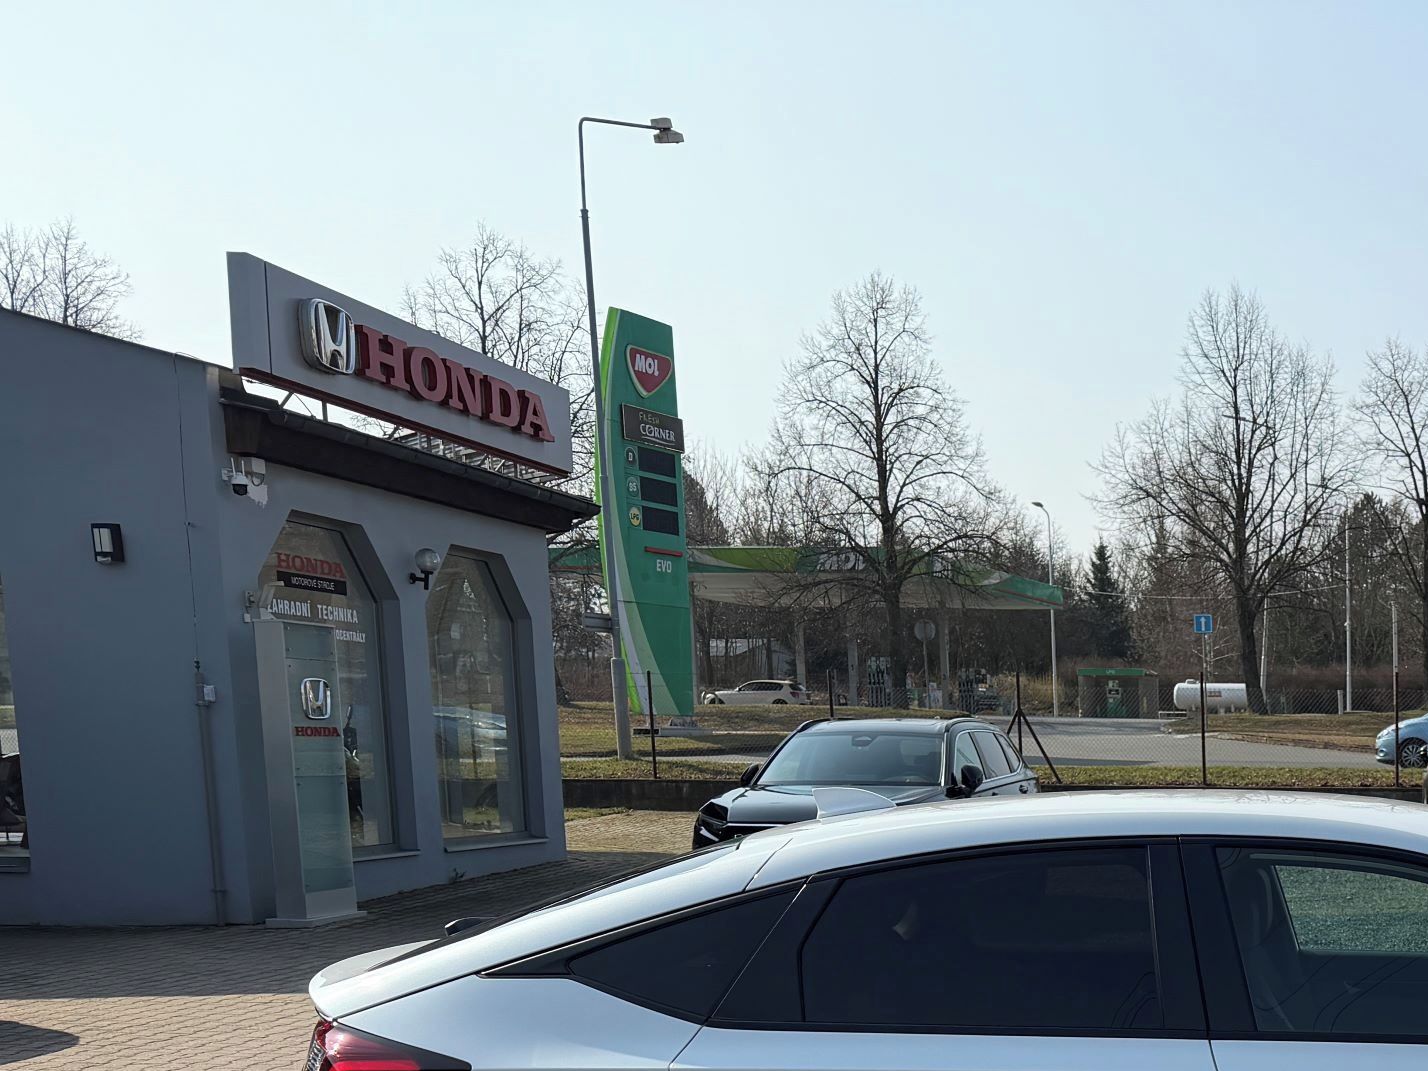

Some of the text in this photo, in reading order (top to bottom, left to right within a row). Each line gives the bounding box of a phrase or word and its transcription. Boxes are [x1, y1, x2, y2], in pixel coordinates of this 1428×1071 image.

[634, 353, 660, 377] MOL
[356, 324, 555, 442] HONDA
[640, 423, 676, 442] CORNER
[630, 512, 640, 521] LPG
[275, 551, 346, 579] HONDA
[656, 558, 672, 573] EVO
[317, 604, 359, 624] TECHNIKA
[294, 726, 341, 737] HONDA
